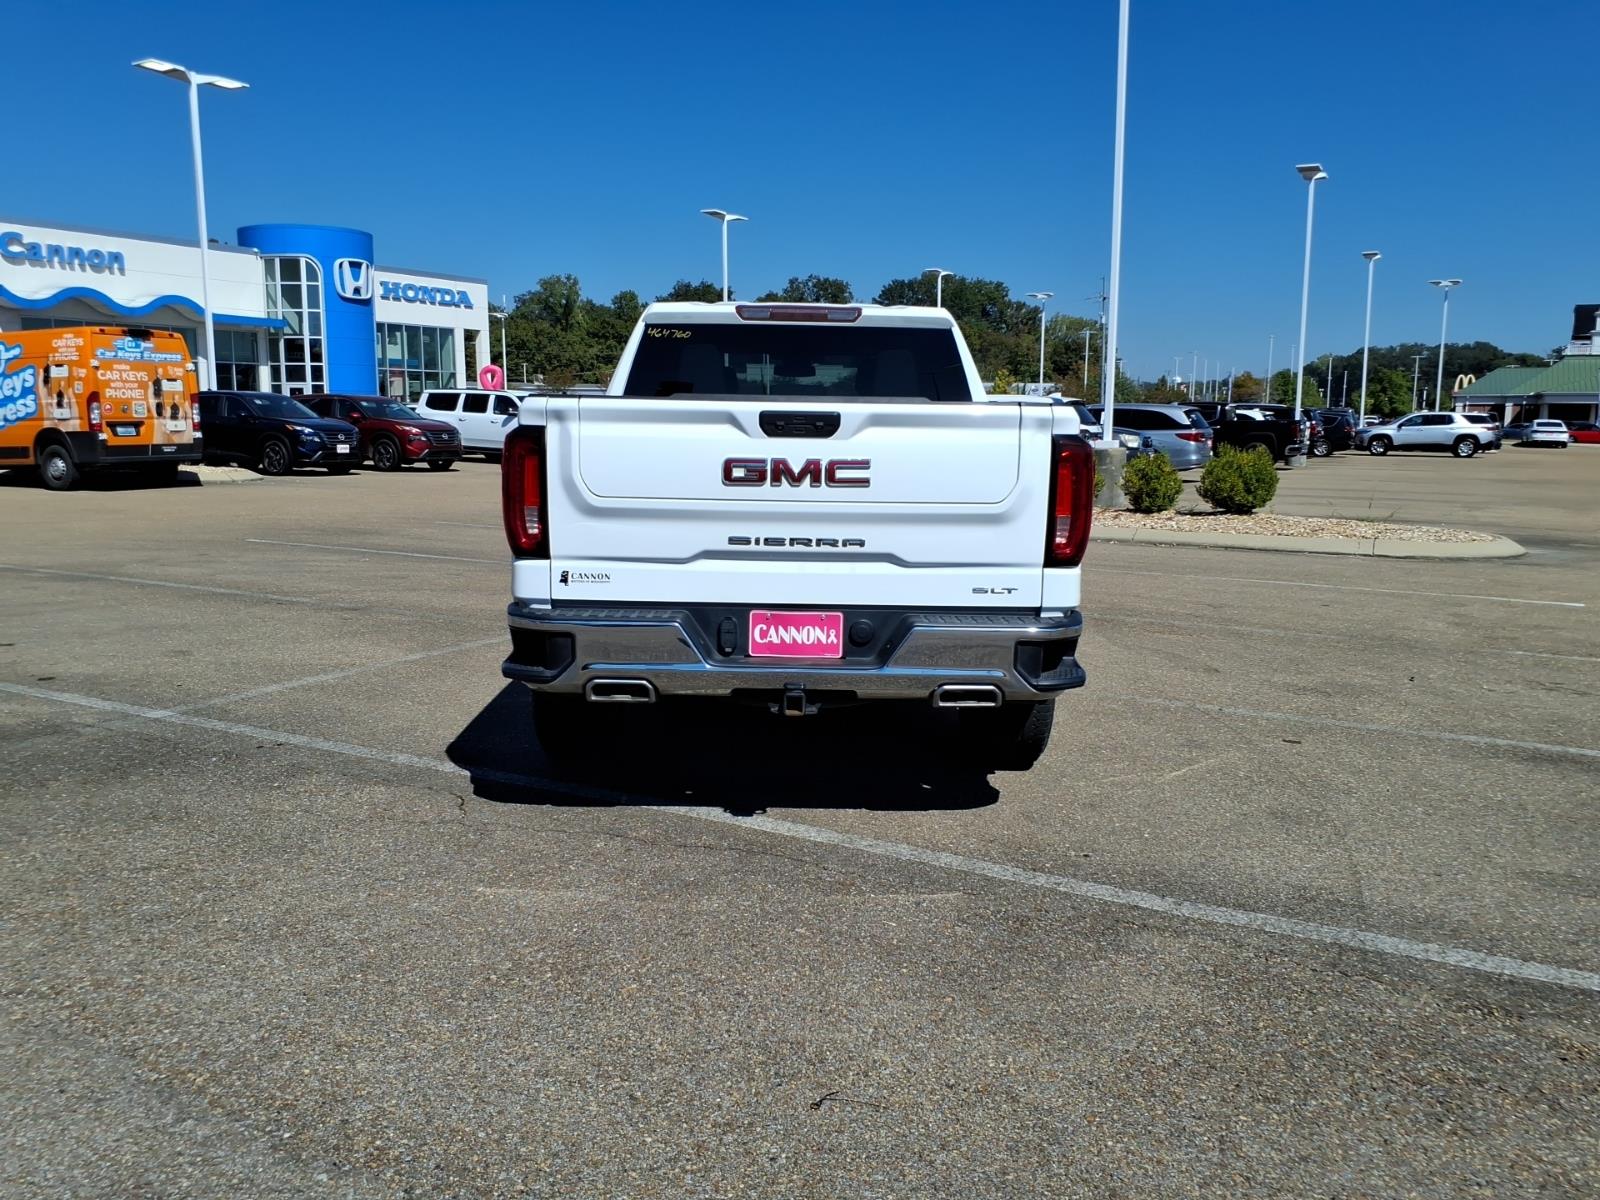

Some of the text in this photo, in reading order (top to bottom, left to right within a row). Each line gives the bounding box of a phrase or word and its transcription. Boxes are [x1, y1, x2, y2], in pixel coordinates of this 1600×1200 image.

[0, 231, 125, 272] Cannon
[379, 280, 474, 309] HONDA
[647, 327, 692, 339] 464760
[97, 349, 182, 362] Car Keys Express
[97, 370, 120, 380] CAR
[122, 371, 149, 381] KEYS
[105, 389, 144, 399] PHONE!
[722, 457, 871, 488] GMC
[728, 535, 866, 548] SIERRA
[571, 572, 611, 580] CANNON
[753, 623, 828, 645] CANNON
